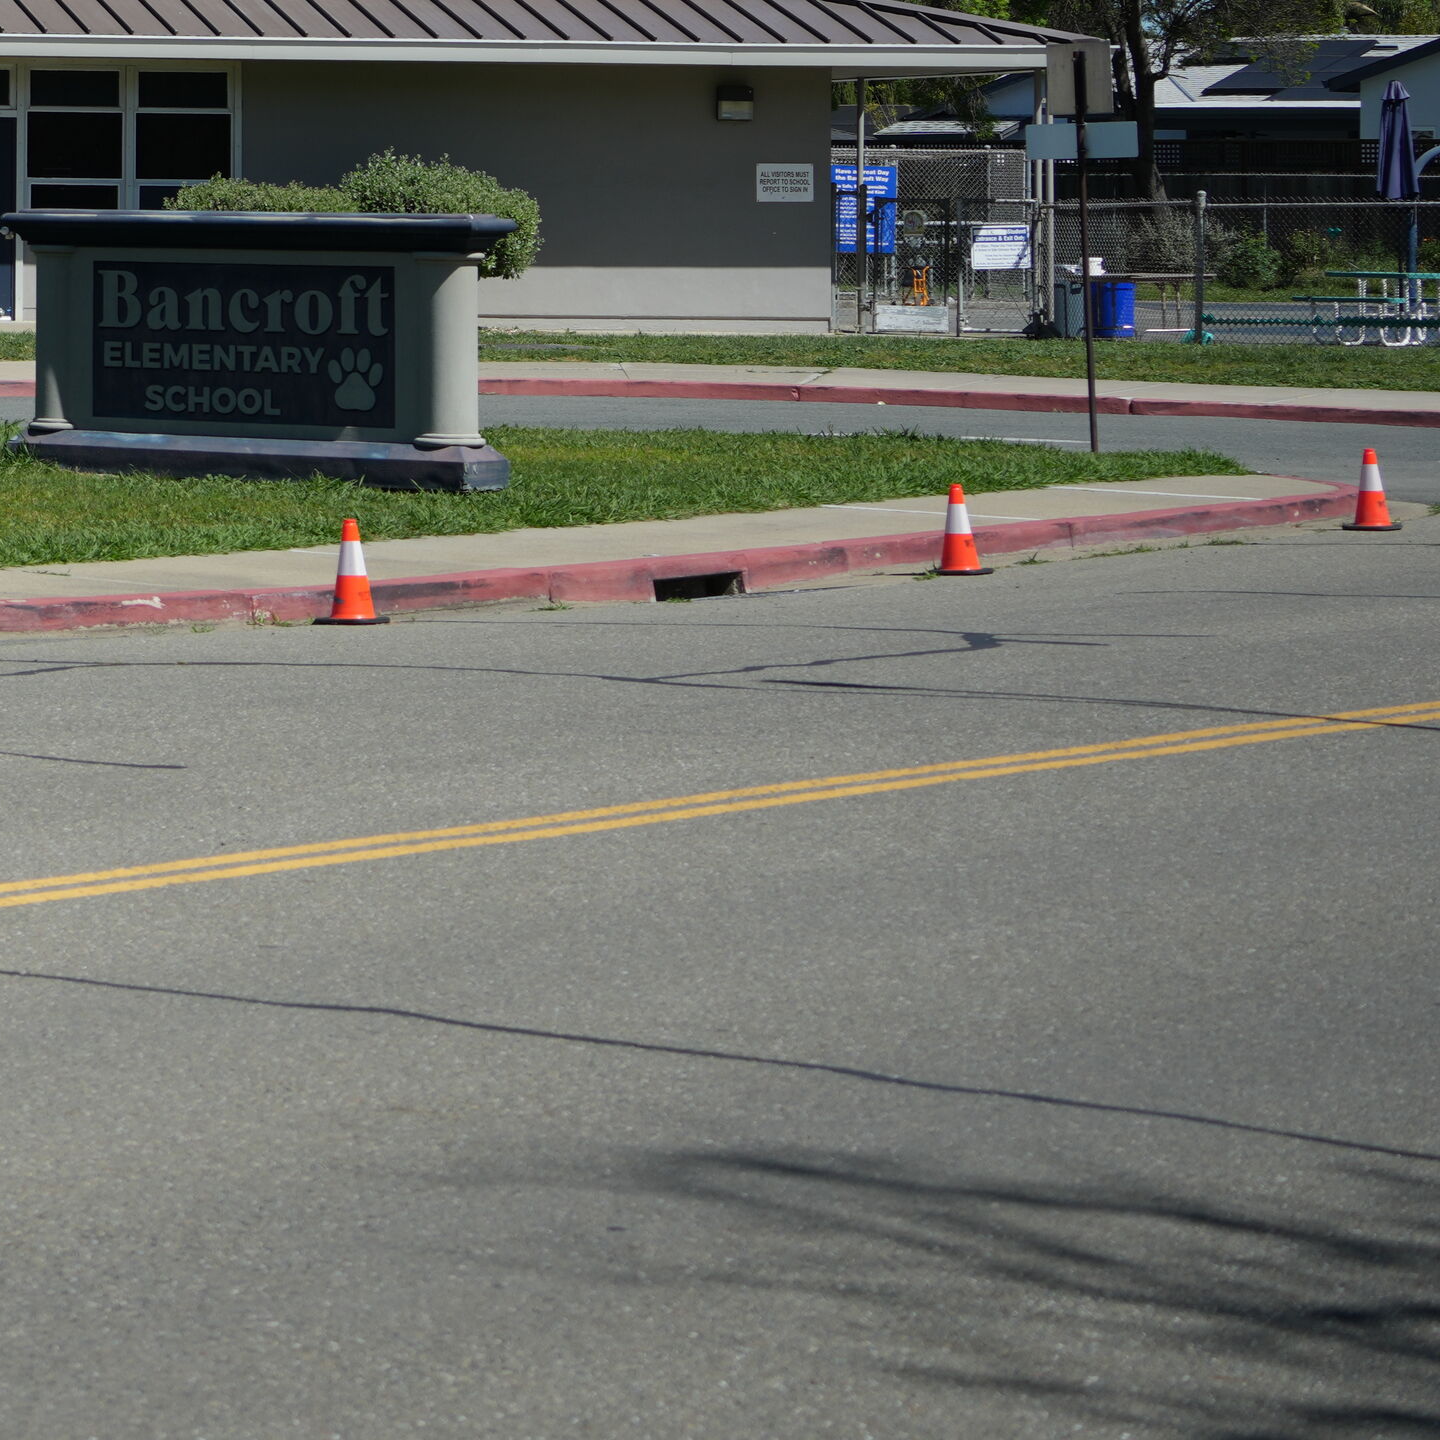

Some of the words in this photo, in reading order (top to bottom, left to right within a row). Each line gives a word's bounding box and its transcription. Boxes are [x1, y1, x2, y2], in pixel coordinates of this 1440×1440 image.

[97, 269, 389, 337] Bancroft
[103, 341, 325, 375] ELEMENTARY
[144, 385, 281, 416] SCHOOL
